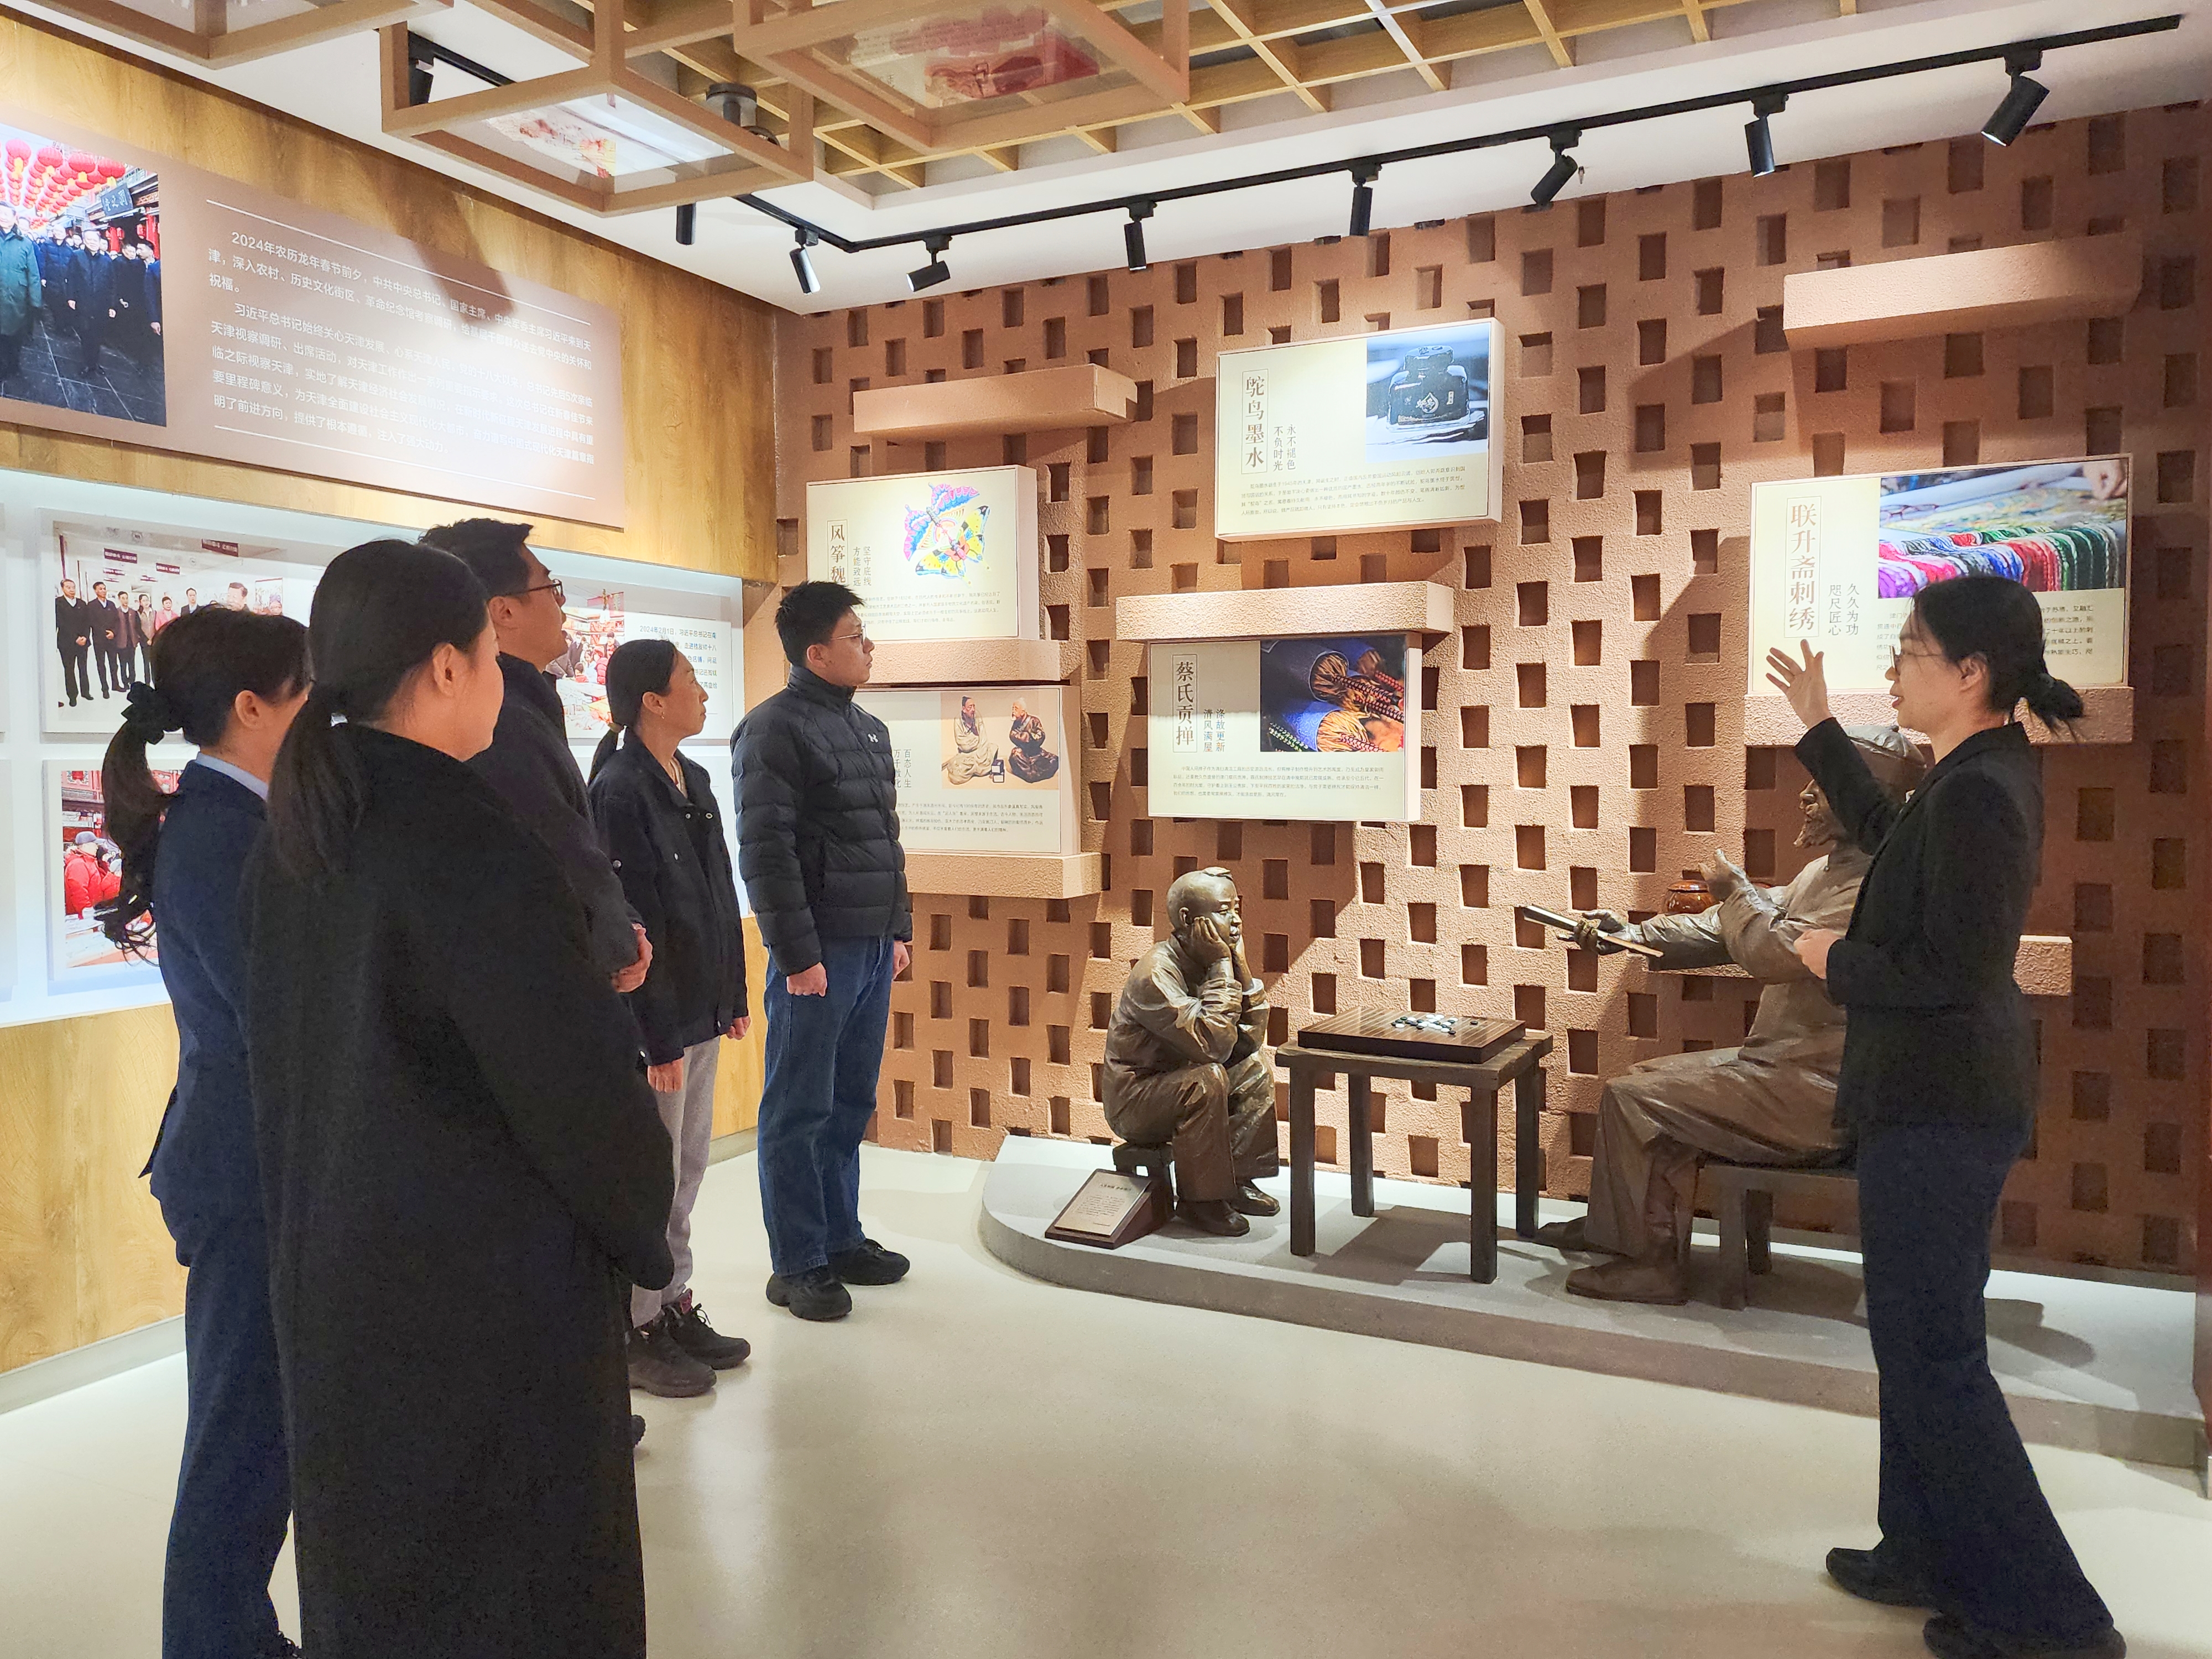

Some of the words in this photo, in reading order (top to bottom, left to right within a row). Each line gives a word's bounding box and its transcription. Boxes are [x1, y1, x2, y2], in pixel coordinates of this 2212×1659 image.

[209, 272, 241, 293] 祝福。
[1245, 375, 1265, 468] 鸵鸟墨水
[1286, 424, 1296, 470] 永不褪色
[1273, 426, 1284, 472] 不负时光
[830, 524, 846, 583] 风筝魏
[1789, 504, 1817, 631] 联升斋刺绣
[1828, 585, 1841, 636] 咫尺匠心
[1845, 583, 1860, 635] 久久为功
[1176, 661, 1194, 745] 蔡氏贡掸
[1203, 709, 1213, 753] 清风满屋
[1215, 708, 1225, 753] 涤故更新
